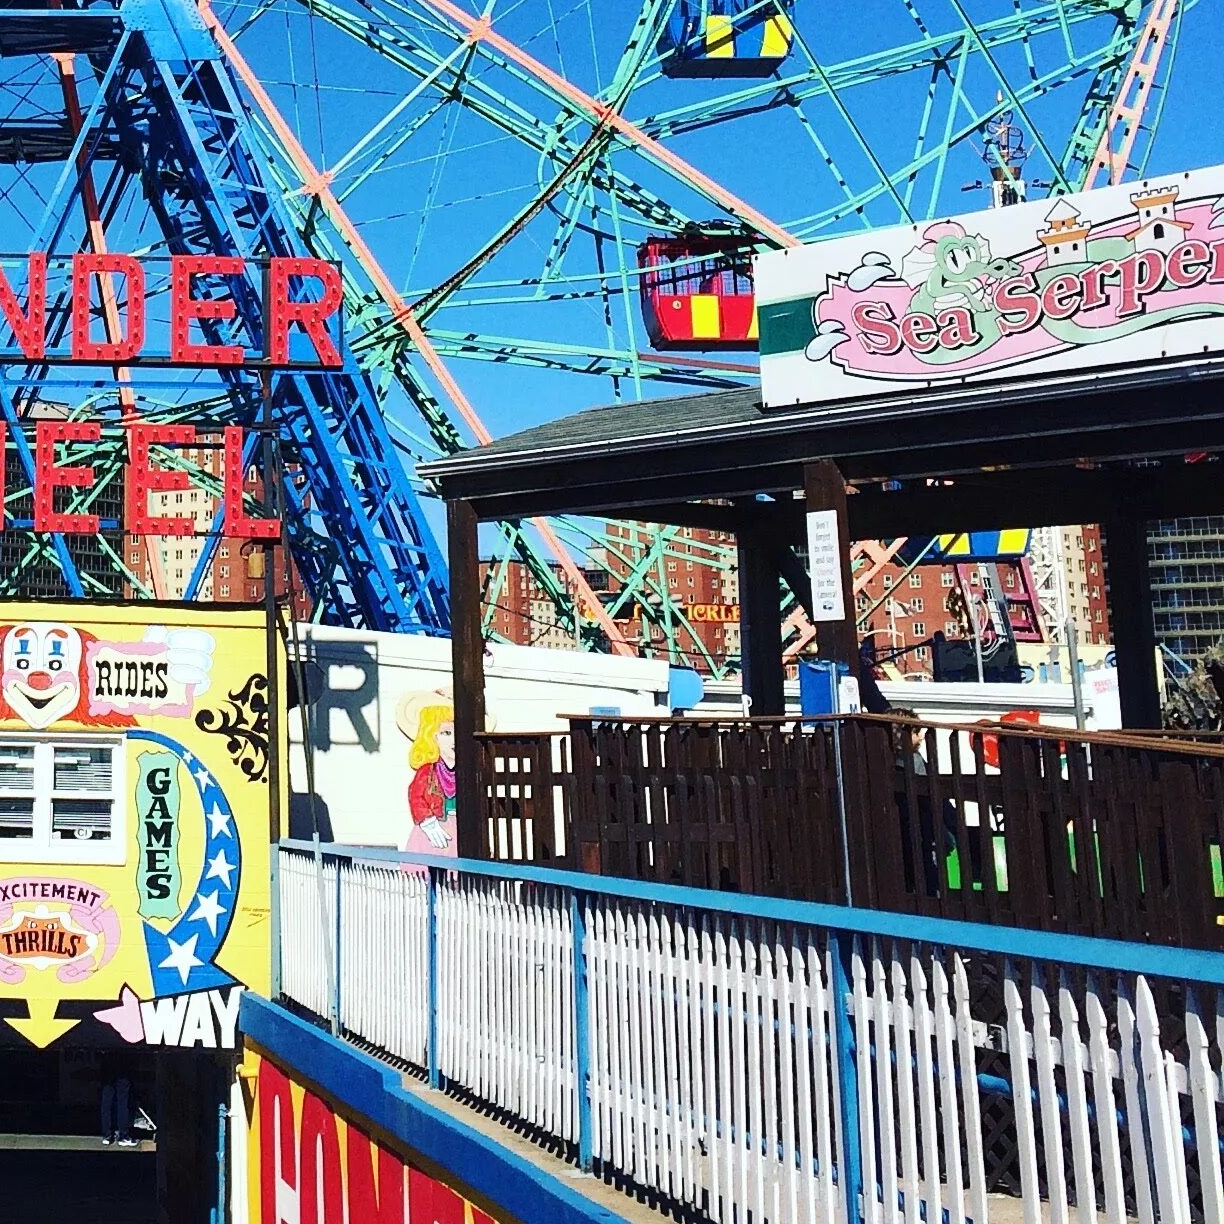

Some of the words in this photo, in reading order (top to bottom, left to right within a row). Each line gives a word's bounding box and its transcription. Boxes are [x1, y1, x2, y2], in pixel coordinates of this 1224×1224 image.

[850, 301, 979, 355] Sea
[95, 660, 169, 699] RIDES
[144, 767, 173, 901] GAMES
[2, 929, 82, 958] THRILLS
[140, 985, 245, 1049] WAY
